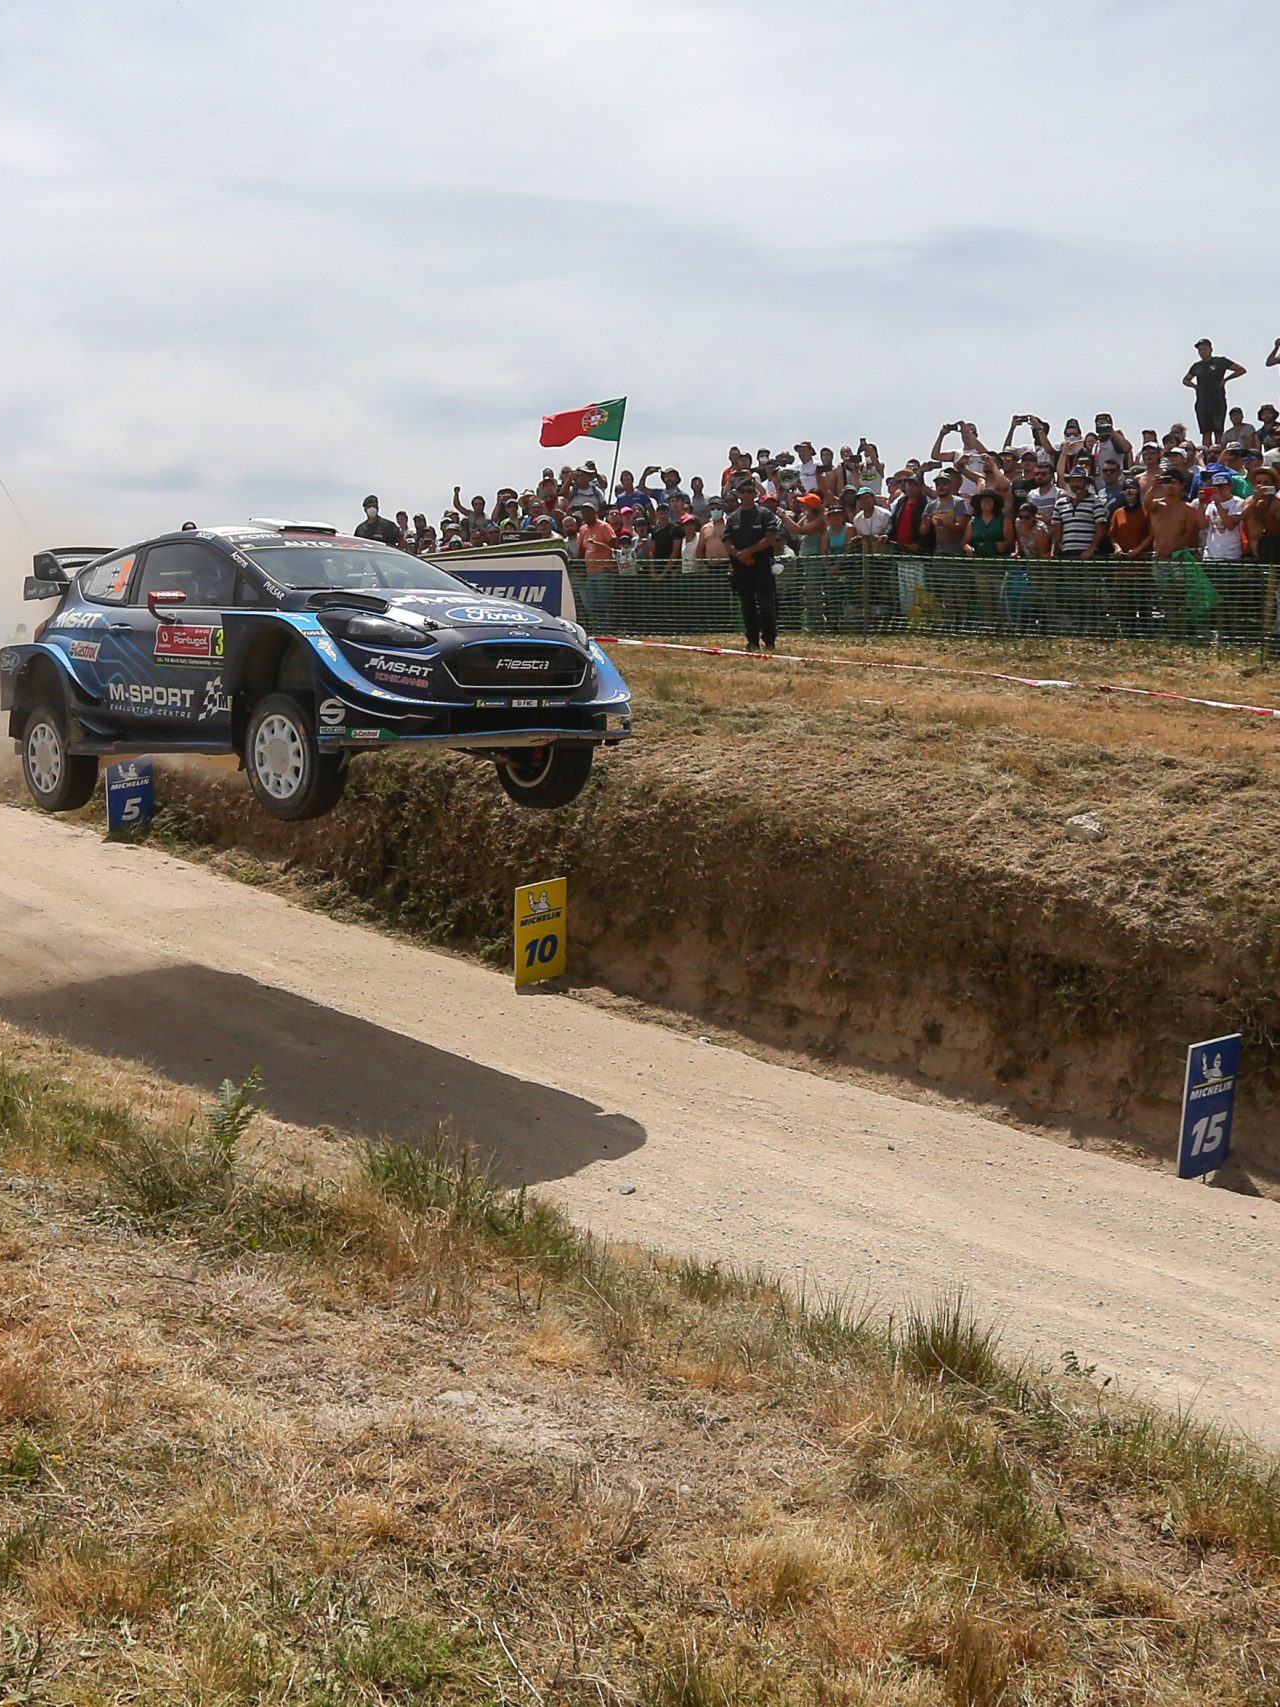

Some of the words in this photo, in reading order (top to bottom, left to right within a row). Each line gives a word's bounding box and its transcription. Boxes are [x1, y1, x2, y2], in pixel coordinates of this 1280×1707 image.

[263, 580, 285, 601] PULSAR
[465, 607, 529, 621] Ford
[173, 635, 208, 647] Portugal
[215, 629, 224, 656] 3
[496, 658, 550, 670] Fiesta
[109, 703, 154, 714] EVALUATION
[157, 708, 192, 719] CENTRE
[110, 778, 150, 791] MICHELIN
[121, 797, 142, 821] 5
[519, 910, 562, 927] MICHELIN
[524, 933, 559, 968] 10
[1188, 1080, 1234, 1101] MICHELIN
[1190, 1111, 1228, 1157] 15
